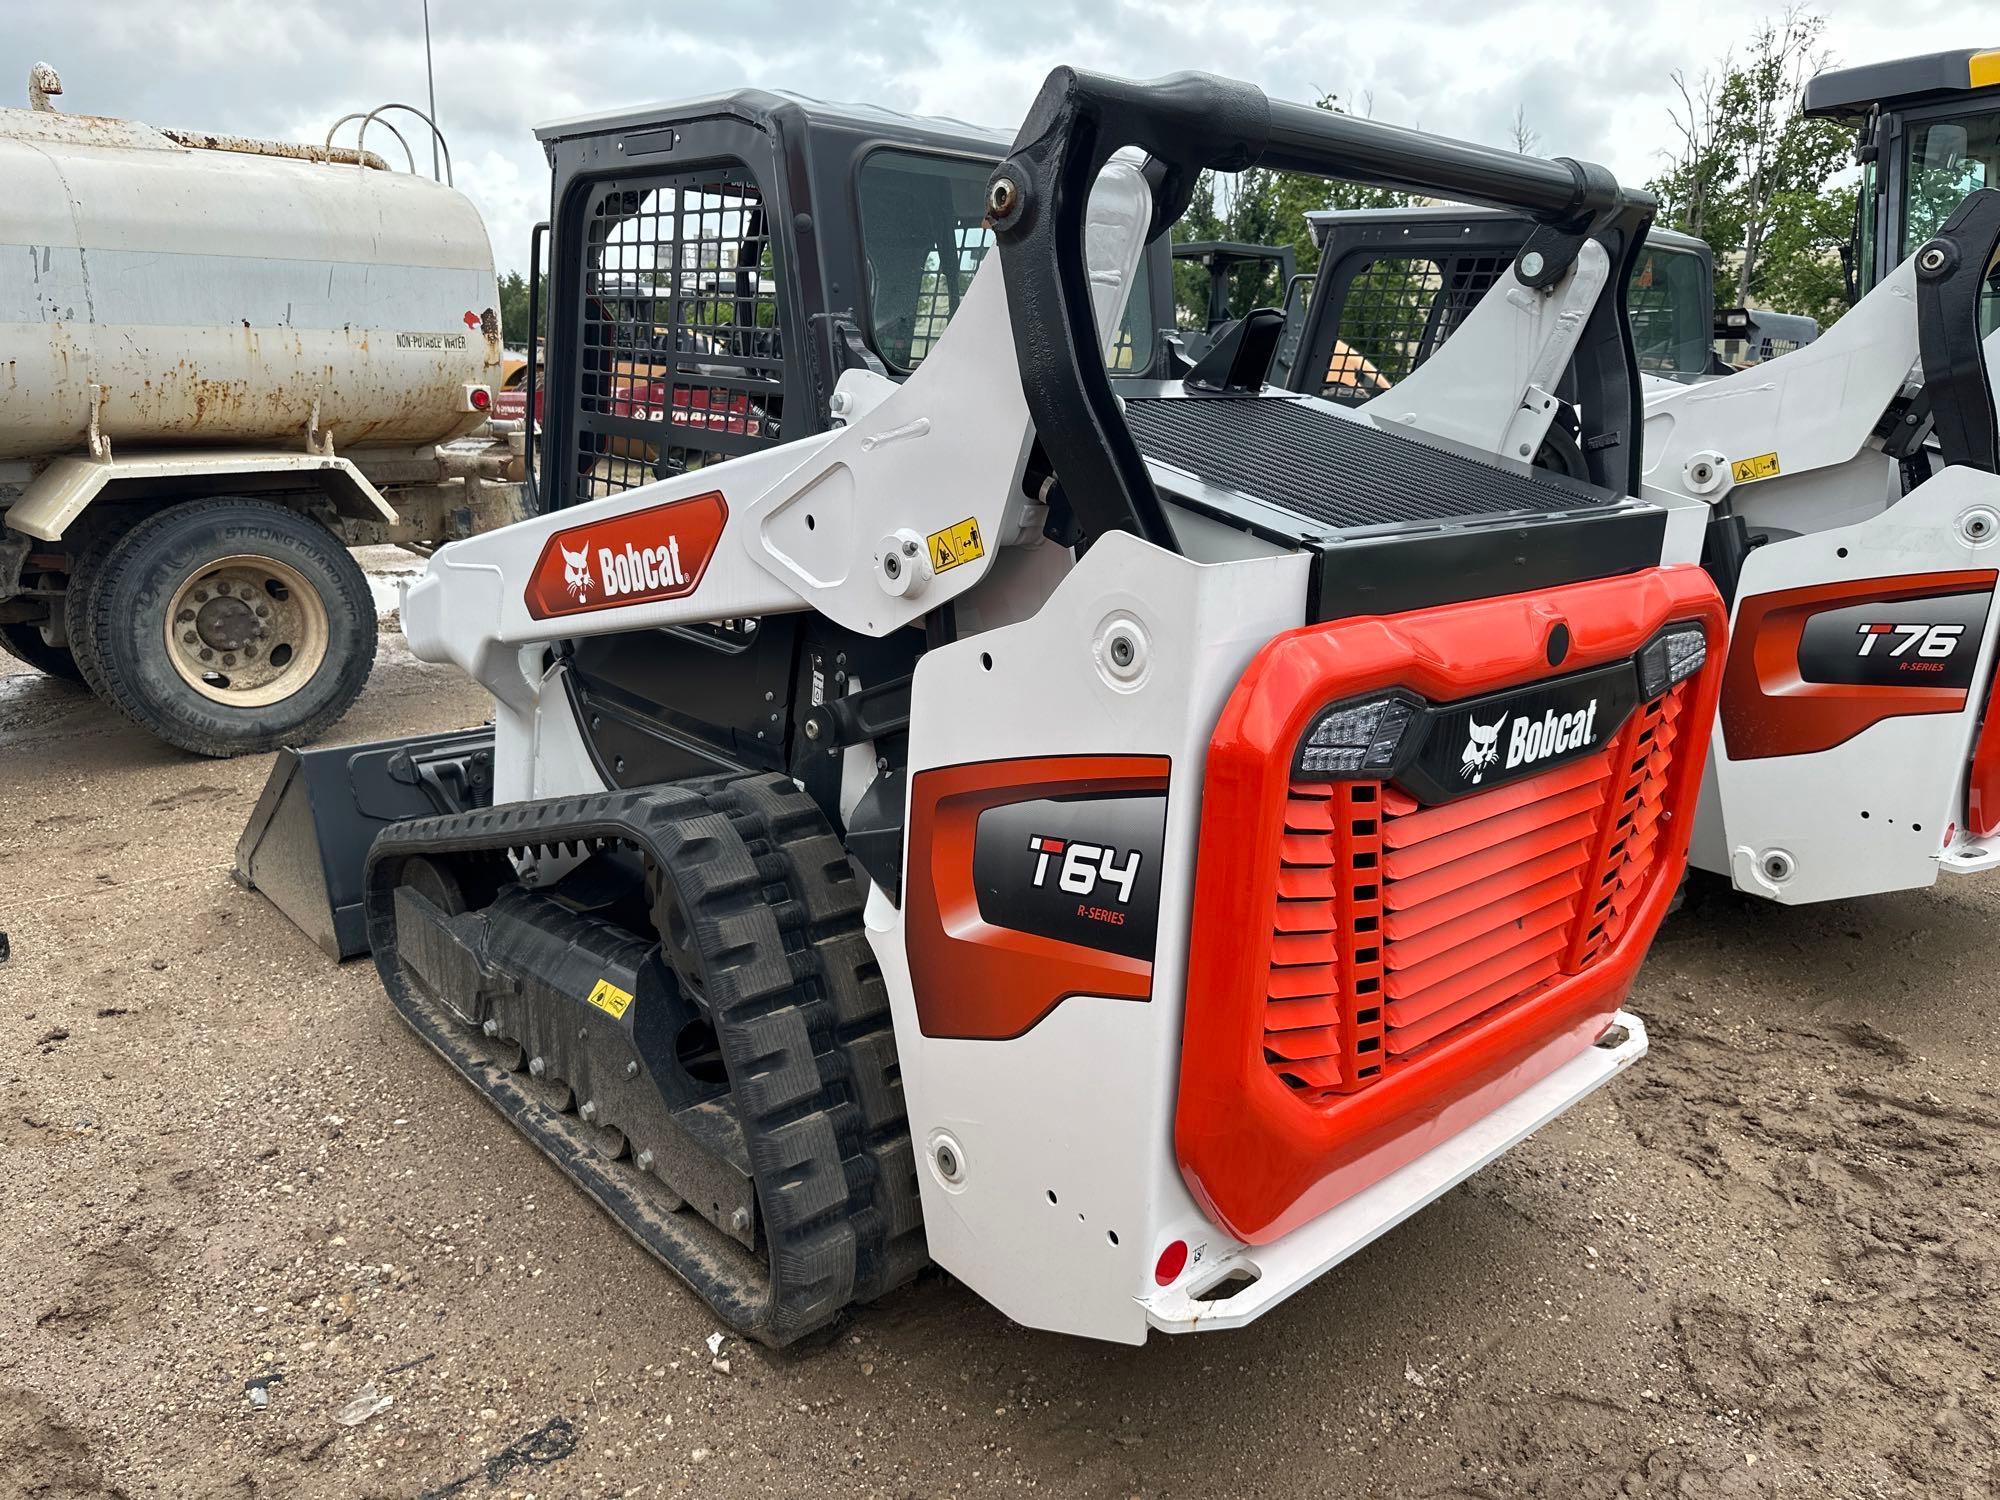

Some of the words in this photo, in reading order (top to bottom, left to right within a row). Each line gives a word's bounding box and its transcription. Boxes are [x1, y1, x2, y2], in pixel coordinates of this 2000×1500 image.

[443, 335, 466, 349] WATER
[225, 526, 296, 546] STRONG
[297, 541, 343, 585] GUARD
[598, 535, 684, 597] Bobcat
[1857, 623, 1966, 659] T76
[1899, 662, 1945, 672] R-SERIES
[1505, 698, 1597, 769] Bobcat
[1028, 835, 1142, 904] T64
[1077, 904, 1126, 925] R-SERIES
